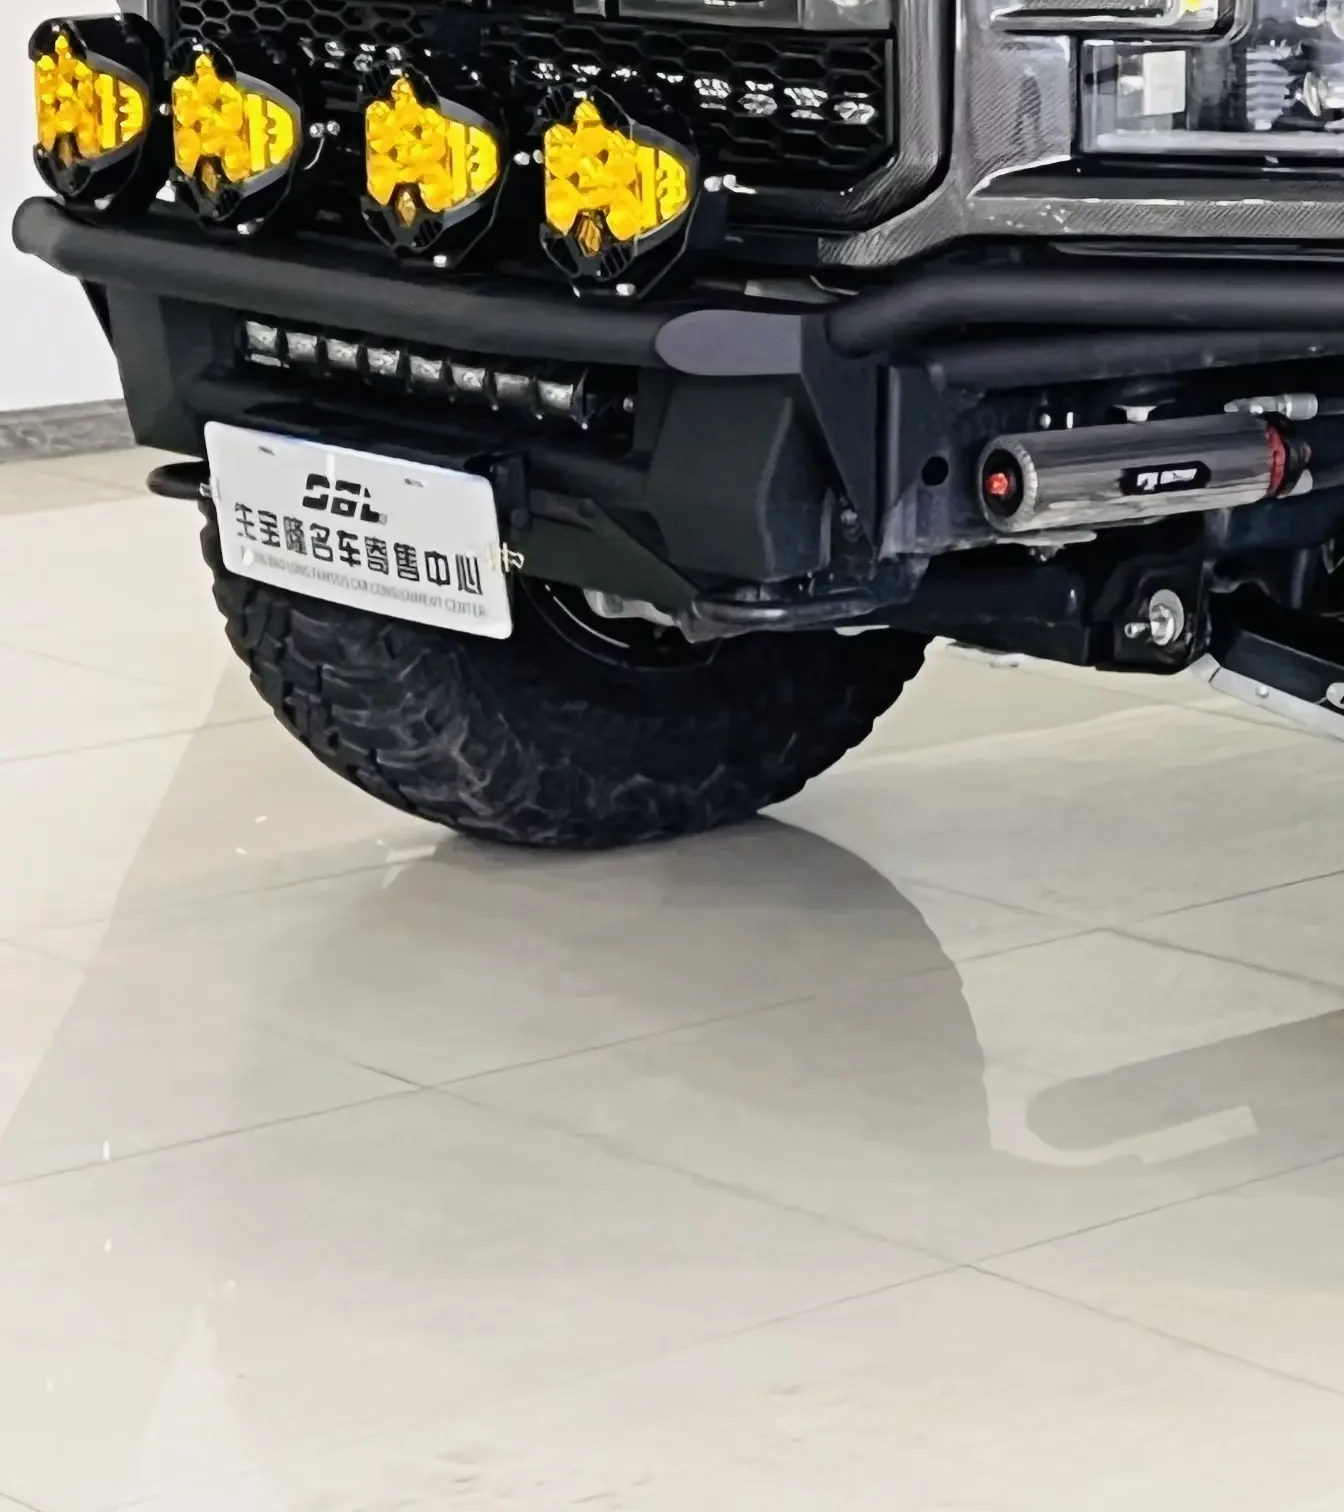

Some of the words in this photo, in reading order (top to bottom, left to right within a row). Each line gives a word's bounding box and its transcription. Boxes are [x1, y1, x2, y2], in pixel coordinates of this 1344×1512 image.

[233, 501, 483, 596] 生宝隆名车寄售中心
